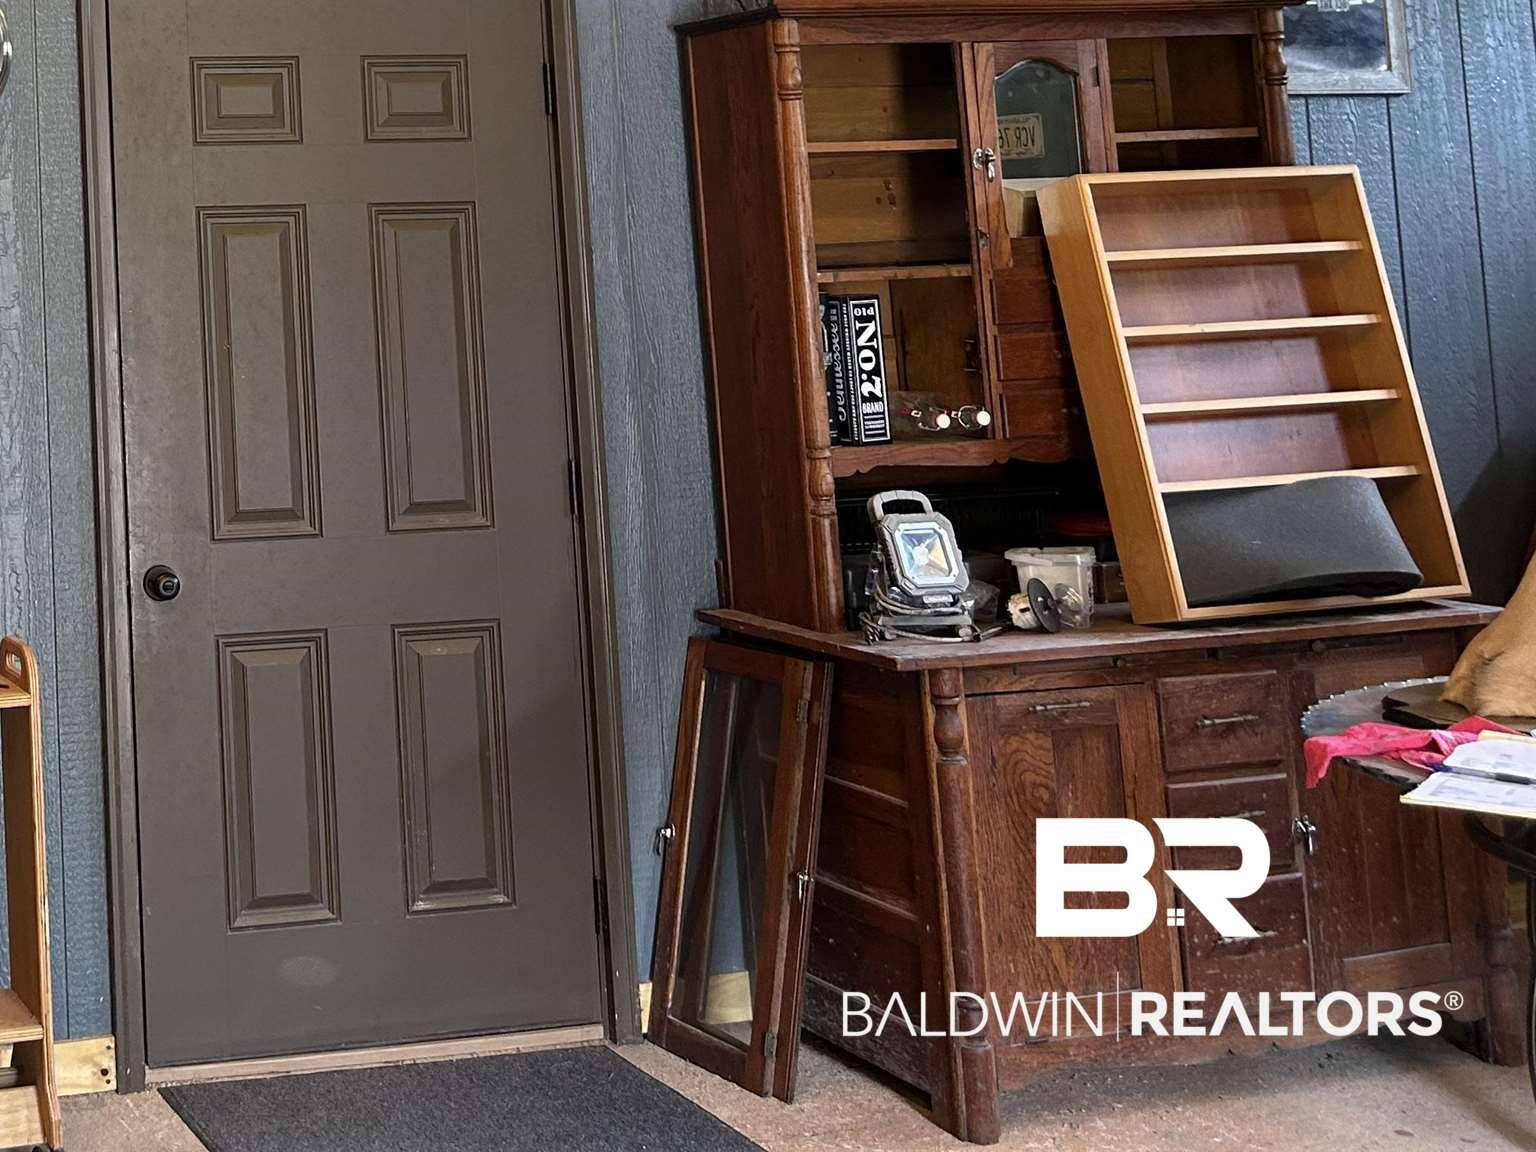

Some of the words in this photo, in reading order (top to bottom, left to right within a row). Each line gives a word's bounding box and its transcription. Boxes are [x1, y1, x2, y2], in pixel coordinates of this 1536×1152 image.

[854, 307, 875, 317] Old
[855, 320, 883, 398] No.7
[863, 401, 884, 414] BRAND
